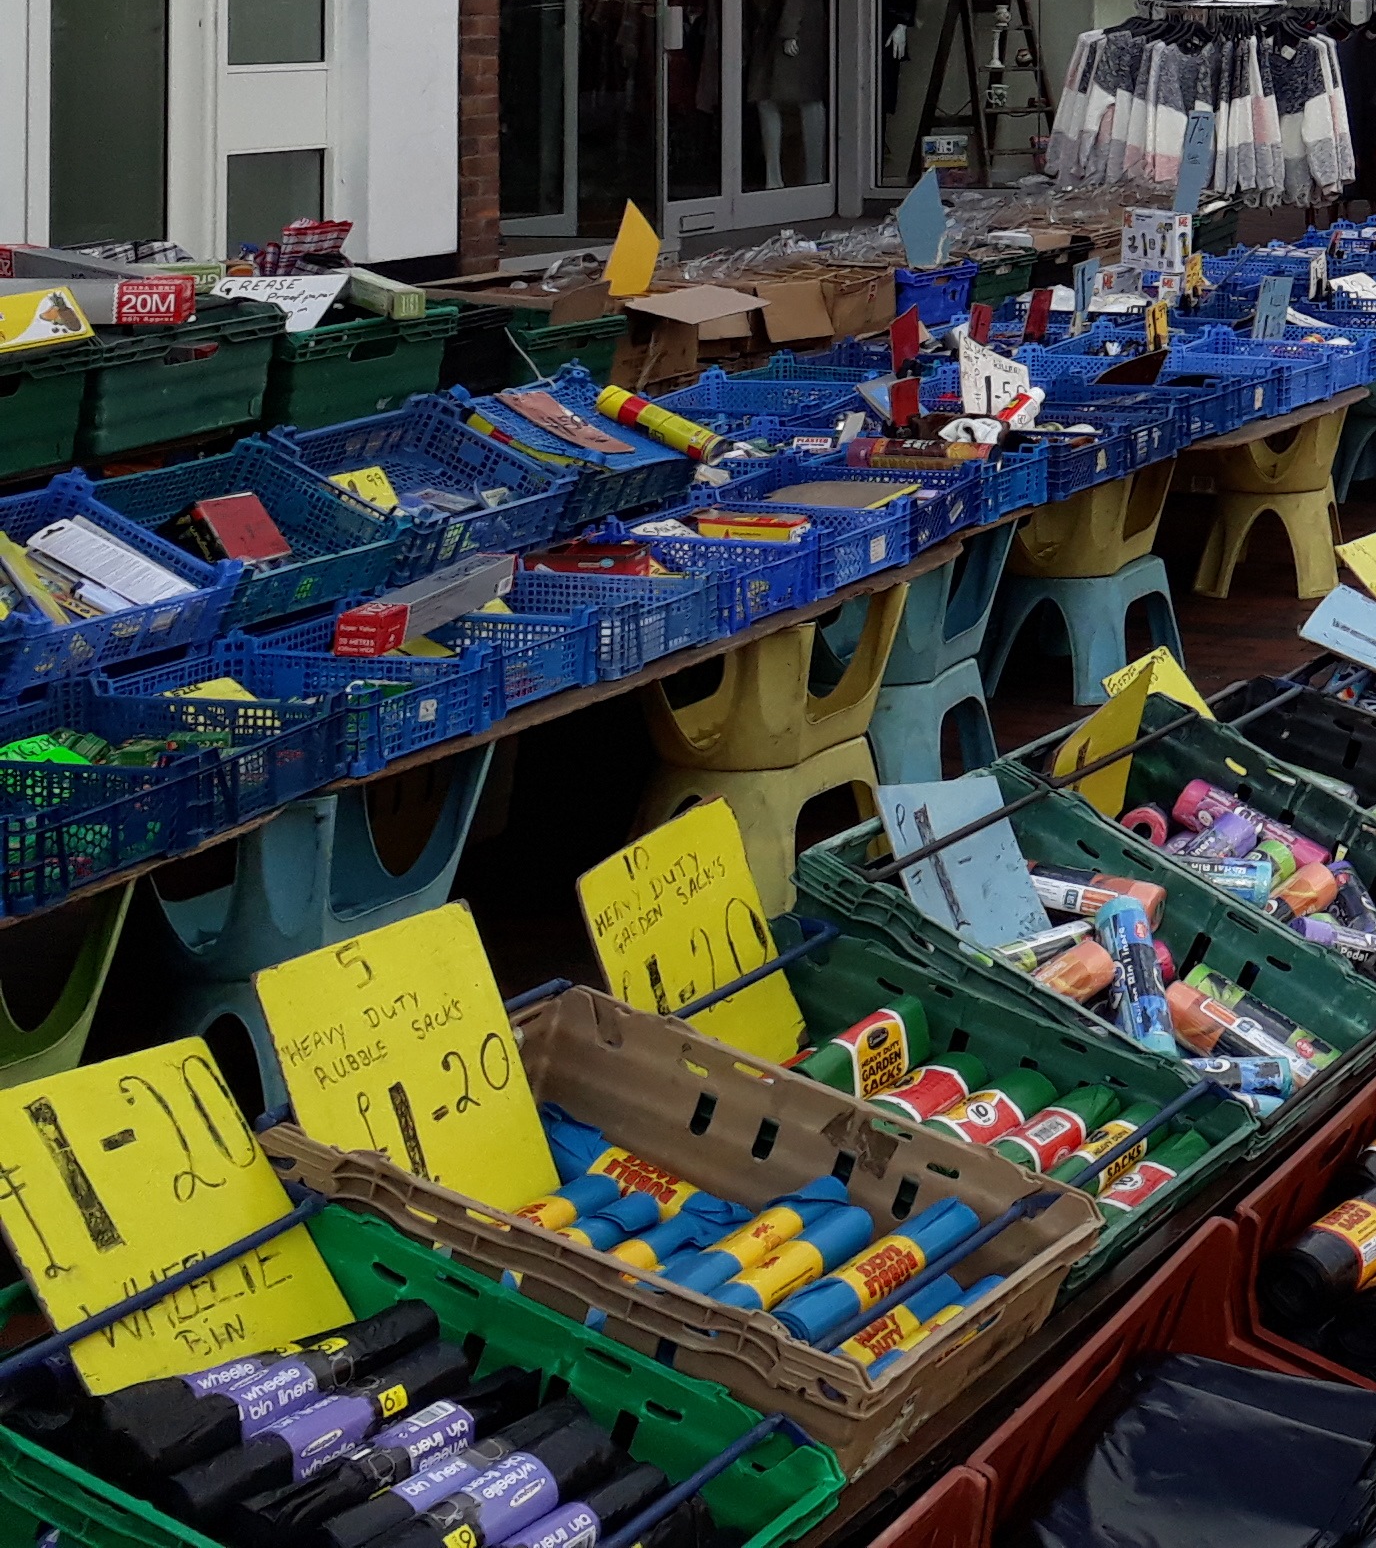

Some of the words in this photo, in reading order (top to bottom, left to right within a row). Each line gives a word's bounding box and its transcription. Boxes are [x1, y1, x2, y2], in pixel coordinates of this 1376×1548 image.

[121, 293, 176, 314] 20M
[219, 278, 303, 296] GREASE
[594, 889, 643, 938] HEAVY
[649, 851, 702, 901] DUTY
[334, 940, 373, 990] 5
[1340, 946, 1370, 965] Pedal
[281, 1023, 347, 1068] HEAVY
[362, 990, 421, 1029] DUTY
[861, 1051, 883, 1069] HEAVY
[883, 1040, 901, 1056] DUTY
[861, 1051, 902, 1081] GARDEN
[863, 1063, 903, 1097] SACKS
[973, 1103, 990, 1119] 10
[1106, 1143, 1142, 1177] SACKS
[604, 1157, 680, 1205] RUBBLE
[197, 1361, 255, 1390] wheelie
[241, 1366, 300, 1401] wheelie
[250, 1398, 274, 1421] bin
[277, 1376, 315, 1407] liners
[409, 1432, 445, 1458] liners
[483, 1461, 538, 1500] wheelie
